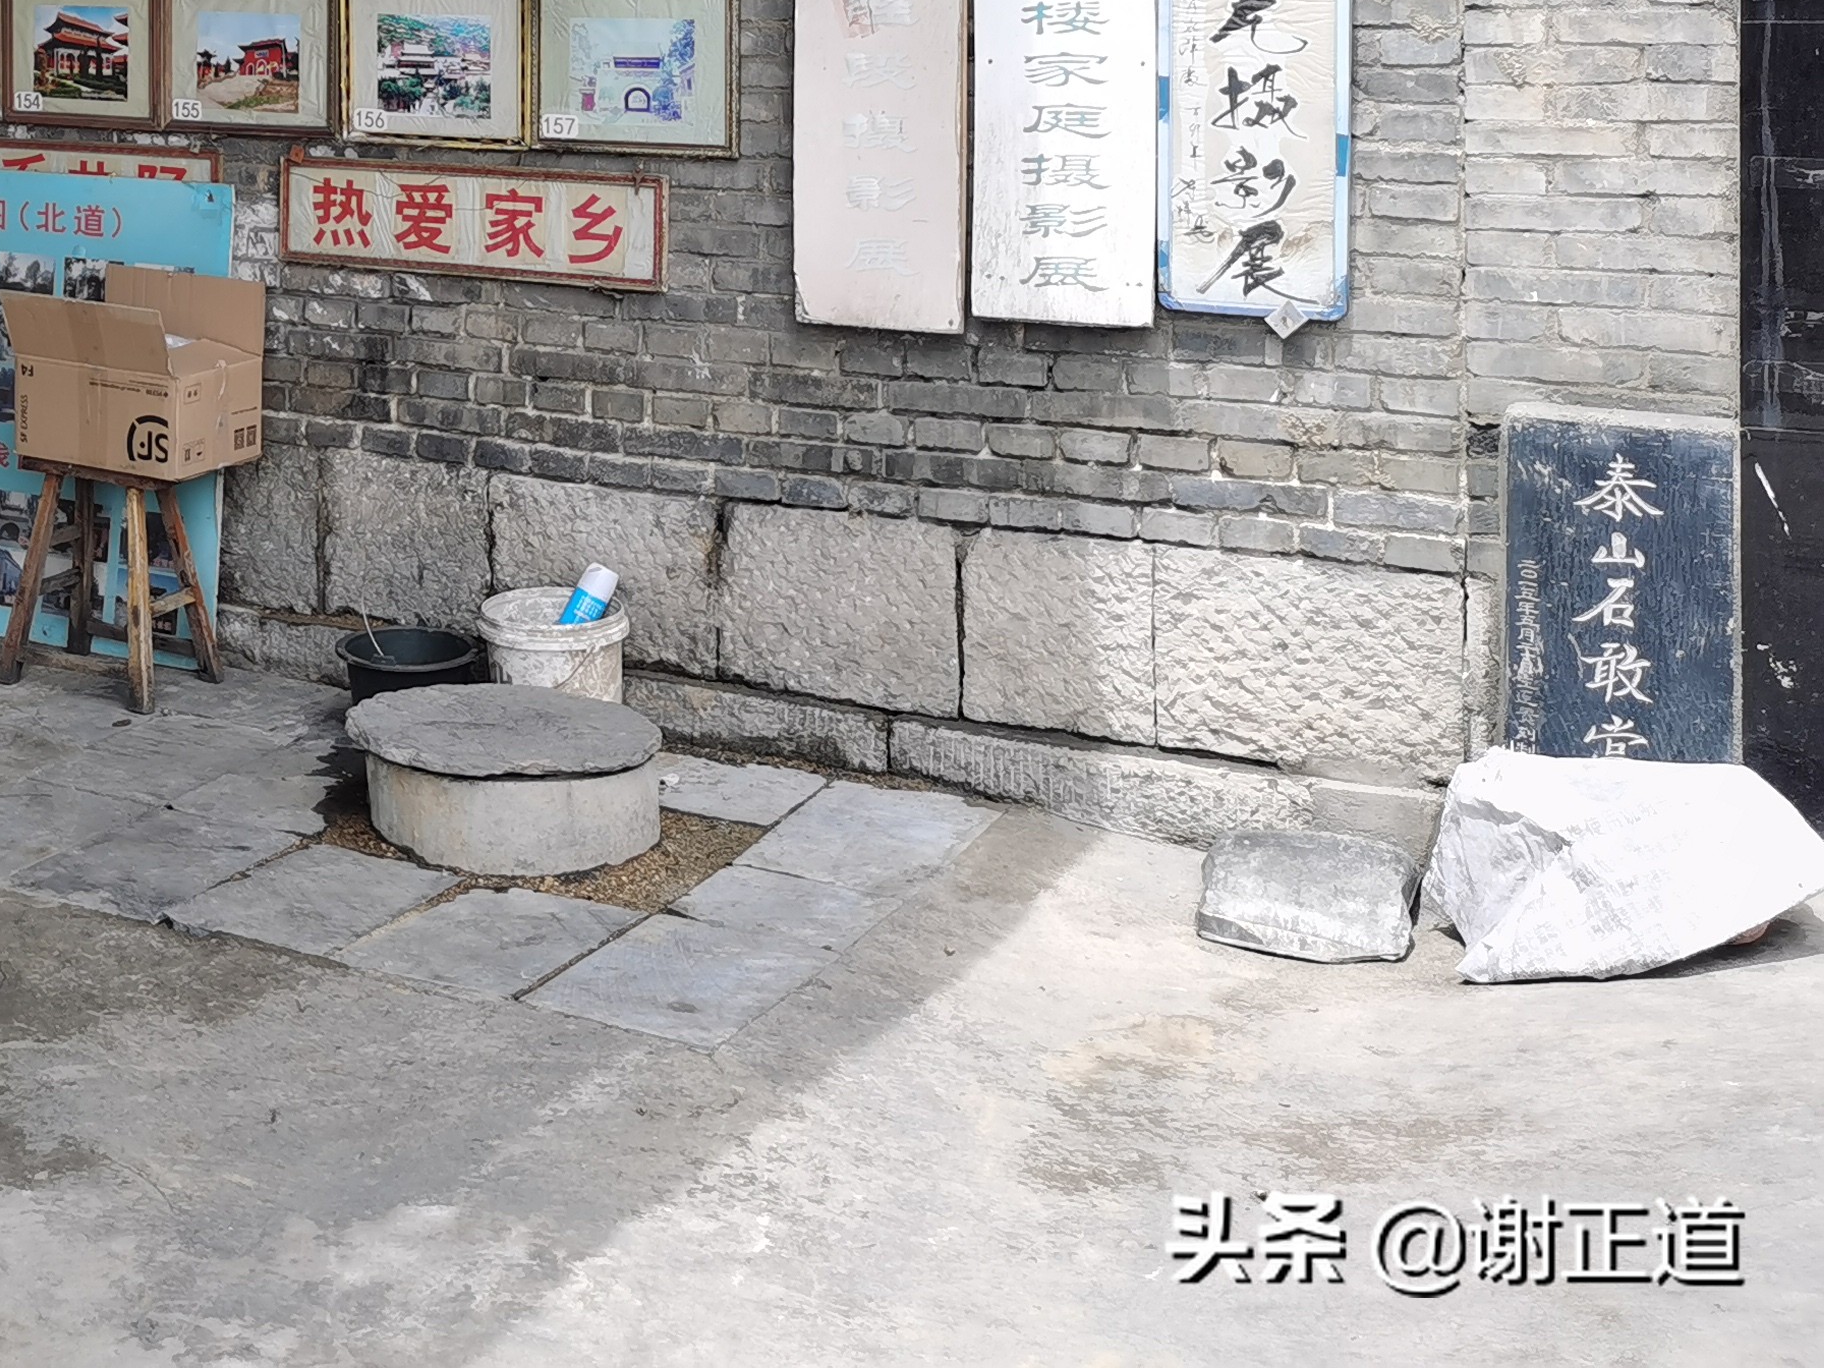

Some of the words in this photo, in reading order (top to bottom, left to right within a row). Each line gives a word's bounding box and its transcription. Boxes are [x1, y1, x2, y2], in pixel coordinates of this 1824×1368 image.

[16, 93, 40, 109] 154
[174, 102, 199, 118] 155
[356, 111, 384, 127] 156
[544, 118, 574, 135] 157
[312, 177, 623, 264] 热爱家乡
